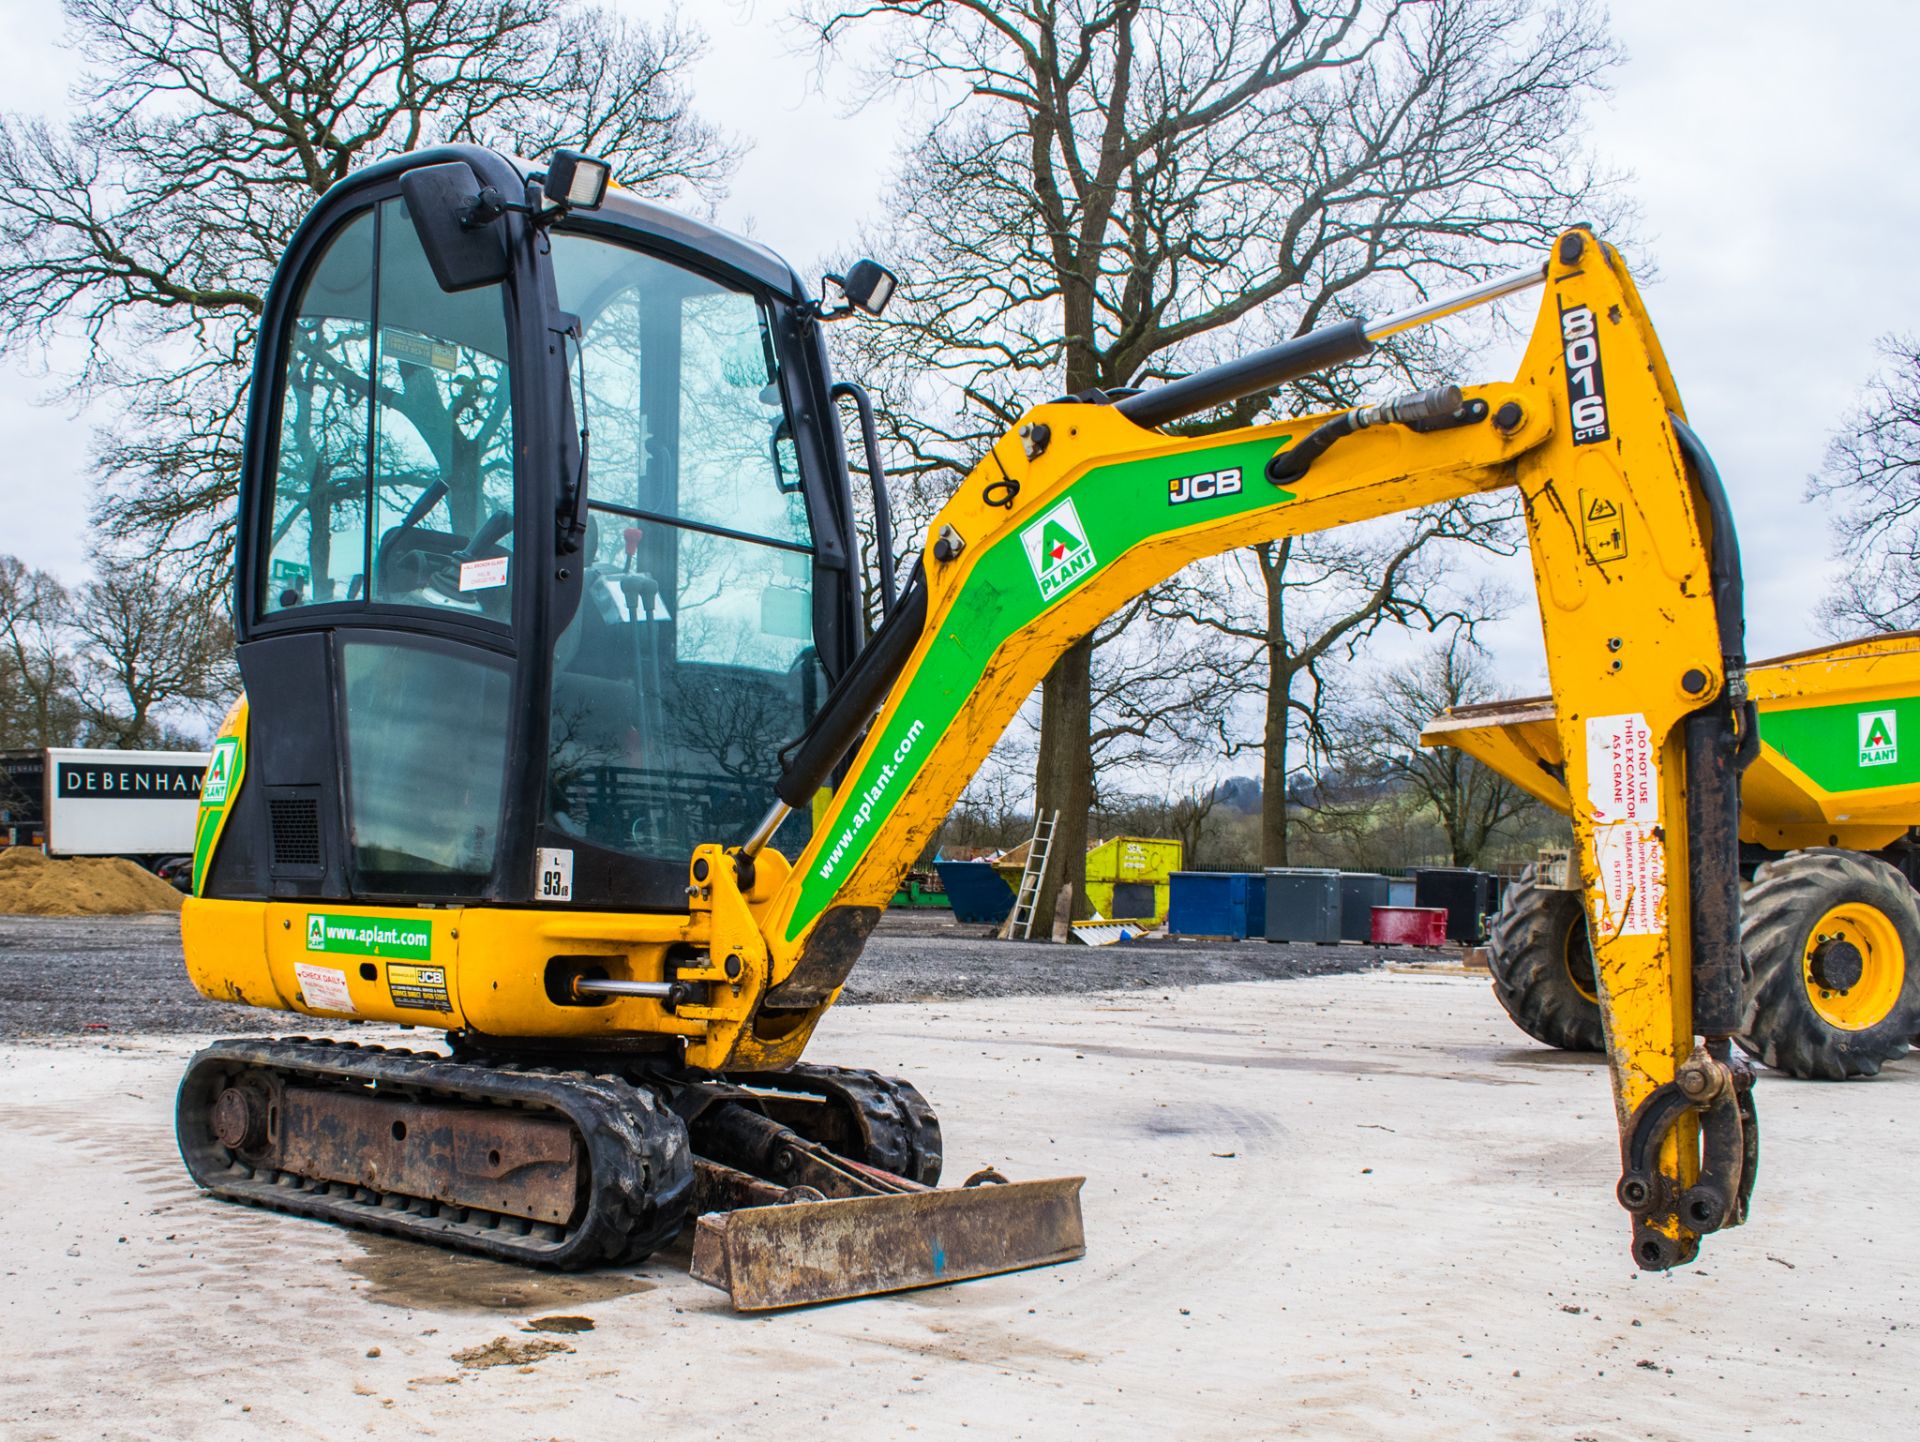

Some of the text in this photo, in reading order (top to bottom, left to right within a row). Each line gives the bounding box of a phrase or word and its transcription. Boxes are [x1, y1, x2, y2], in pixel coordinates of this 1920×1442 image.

[1562, 307, 1605, 429] 8016
[1575, 425, 1606, 440] CTS
[1170, 468, 1242, 503] JCB
[1041, 519, 1083, 574] A
[1041, 550, 1092, 595] PLANT
[1865, 717, 1893, 748] A
[208, 750, 225, 781] A
[1612, 735, 1622, 804] AS A CRANE
[1625, 717, 1636, 819] THIS EXCAVATOR
[1638, 730, 1648, 804] DO NOT USE
[1861, 749, 1896, 763] PLANT
[819, 719, 925, 879] www.aplant.com
[1625, 830, 1633, 870] BREAKER
[1638, 842, 1646, 872] DIPPER
[543, 871, 562, 896] 93
[1614, 860, 1622, 900] IS FITTED
[326, 925, 428, 947] www.aplant.com
[417, 970, 443, 984] JCB
